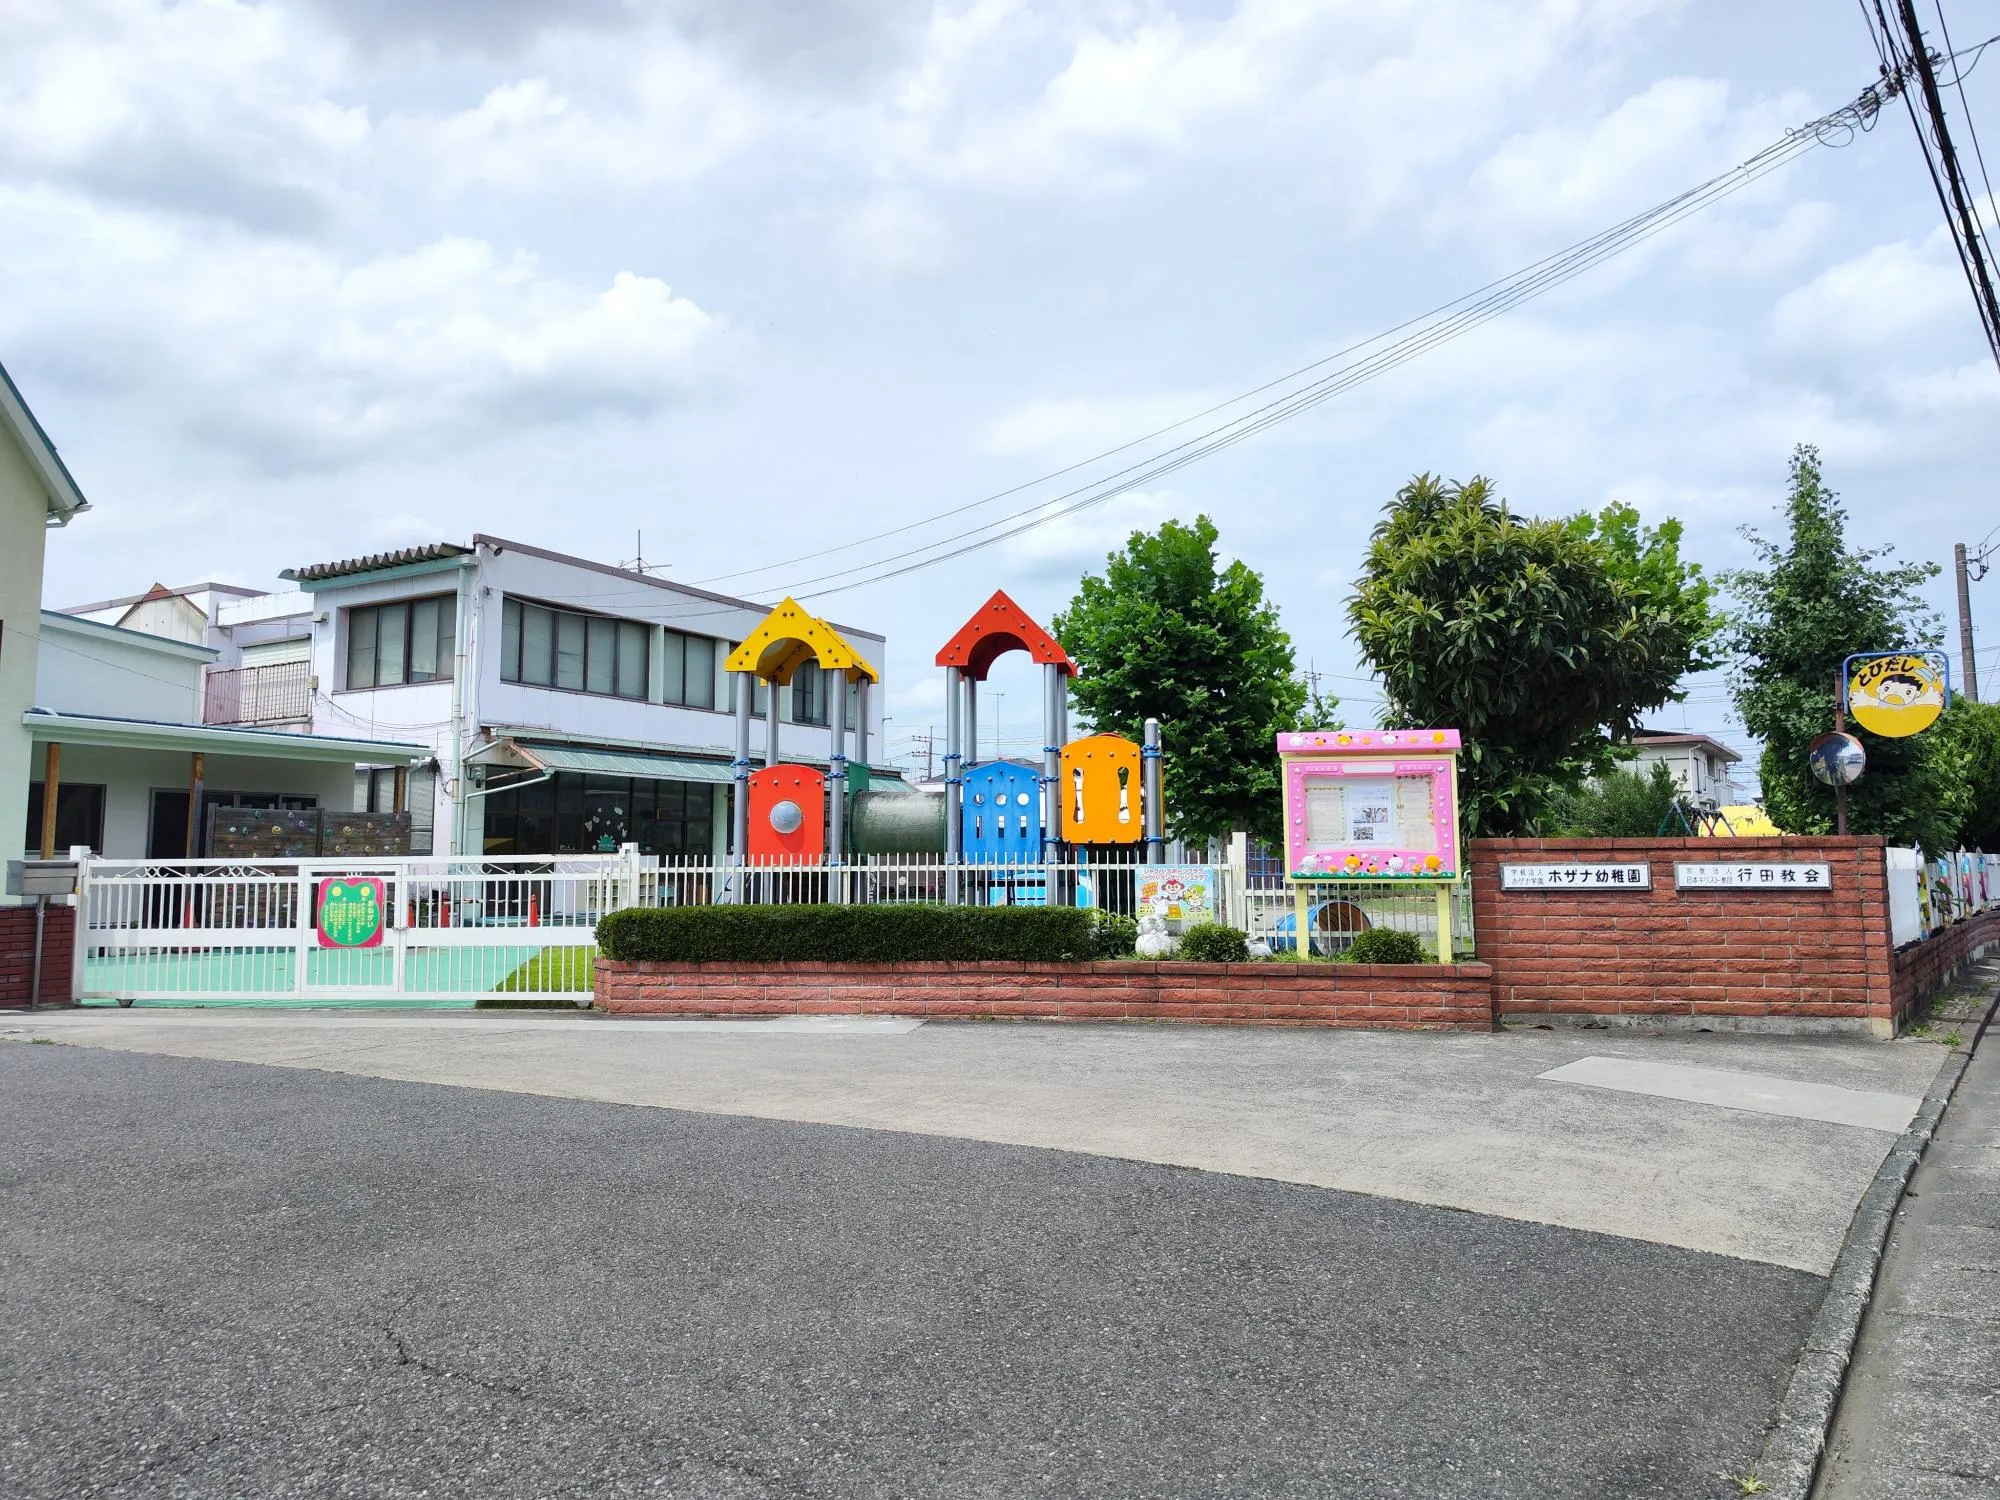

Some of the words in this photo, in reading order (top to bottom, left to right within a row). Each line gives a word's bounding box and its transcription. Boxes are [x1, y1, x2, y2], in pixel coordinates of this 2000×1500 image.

[1511, 877, 1544, 885] ホザナ学園
[1548, 868, 1641, 883] ホザナ幼稚園
[1737, 867, 1820, 883] 行田教会
